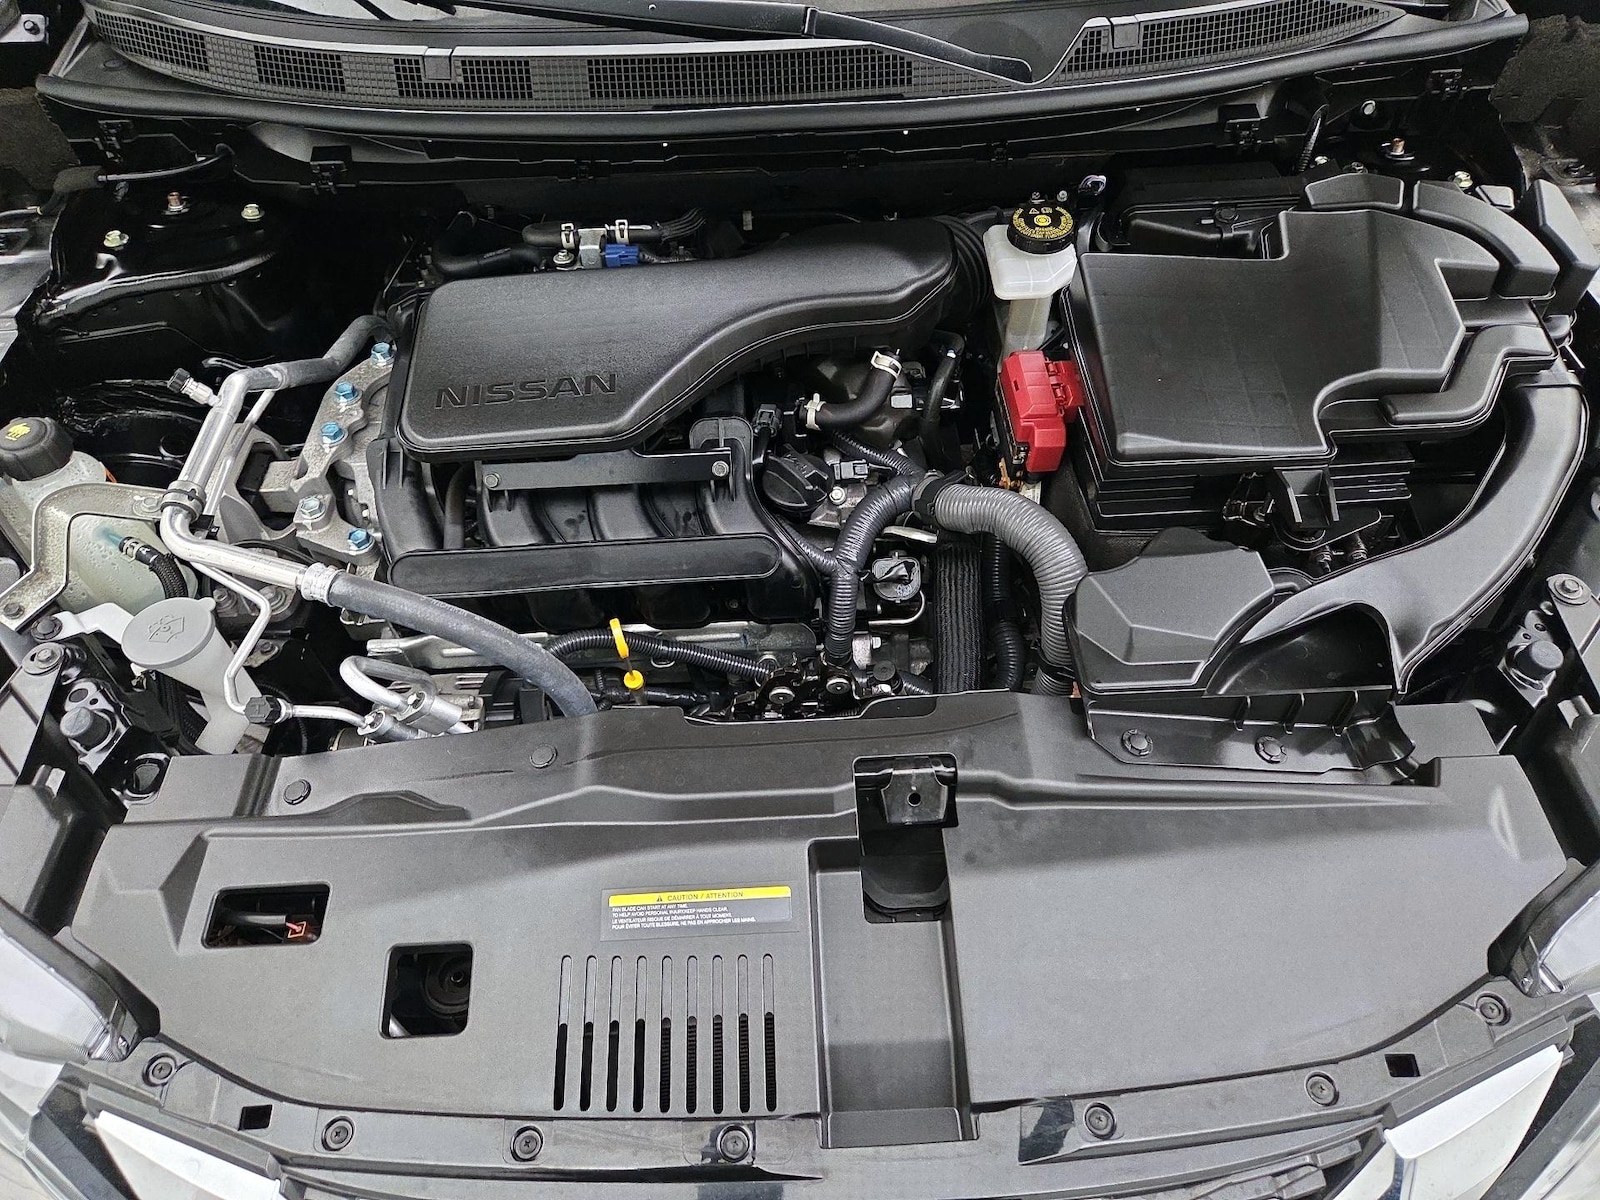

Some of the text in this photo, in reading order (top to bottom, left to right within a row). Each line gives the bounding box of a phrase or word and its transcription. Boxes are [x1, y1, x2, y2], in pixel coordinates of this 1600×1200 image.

[434, 373, 618, 410] NISSAN
[667, 893, 699, 901] CAUTION
[705, 891, 744, 899] ATTENTION
